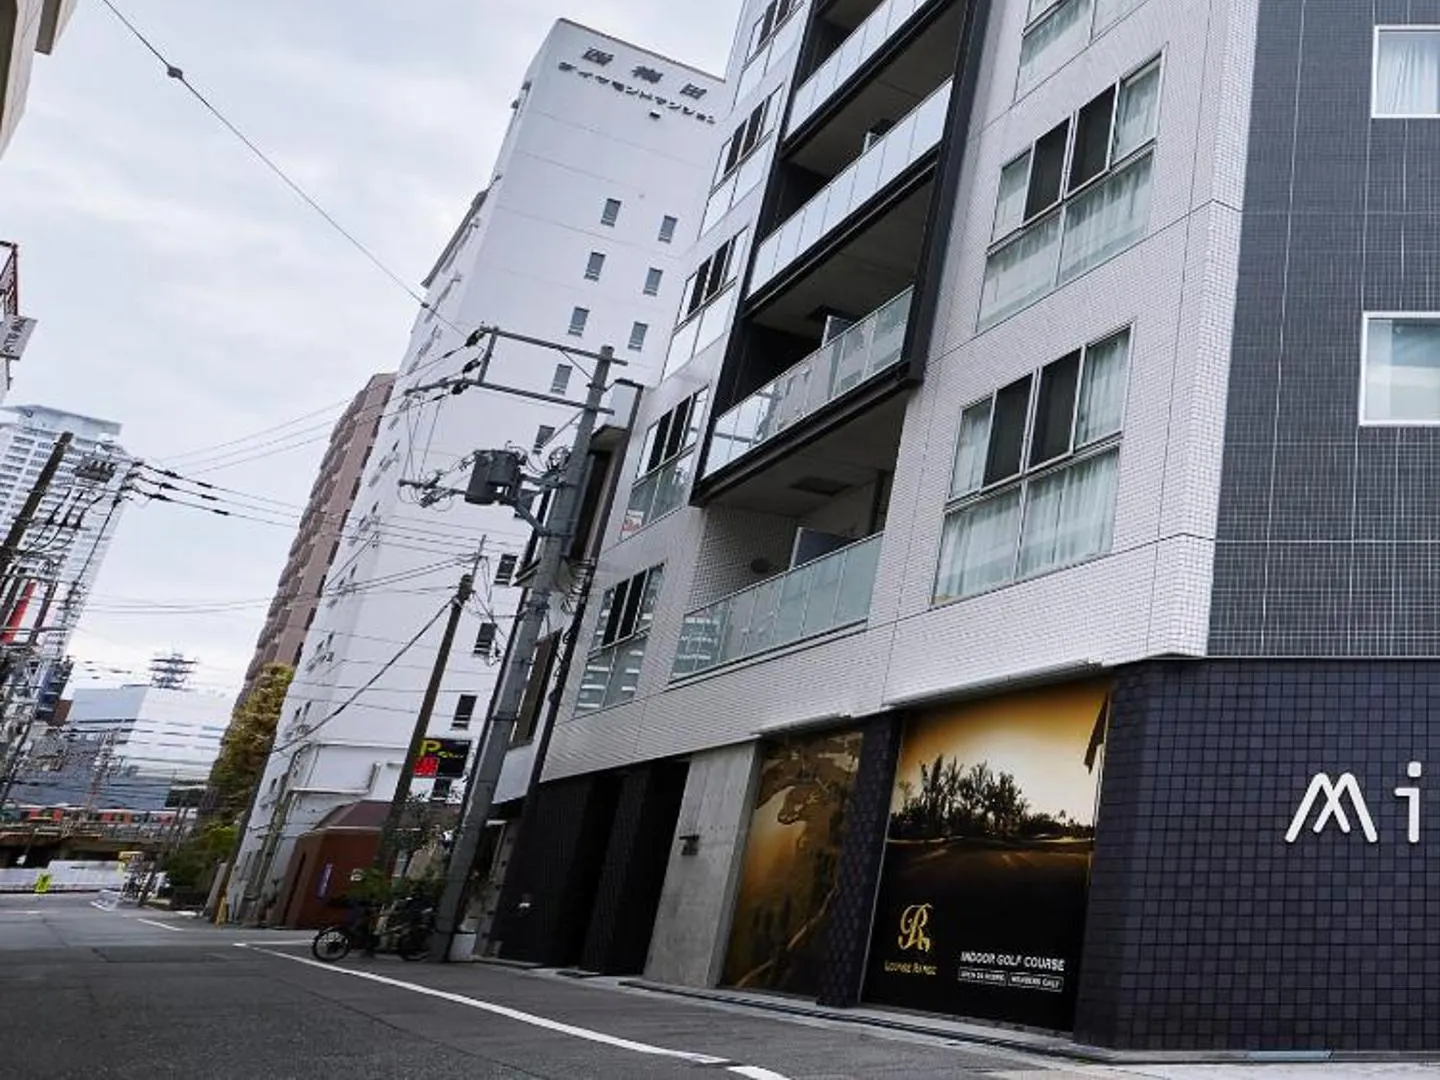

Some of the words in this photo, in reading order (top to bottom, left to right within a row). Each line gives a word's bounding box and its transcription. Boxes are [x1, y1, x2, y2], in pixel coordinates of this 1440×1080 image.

[960, 951, 996, 965] INDOOR
[996, 954, 1022, 967] GOLF
[1023, 956, 1066, 972] COURSE
